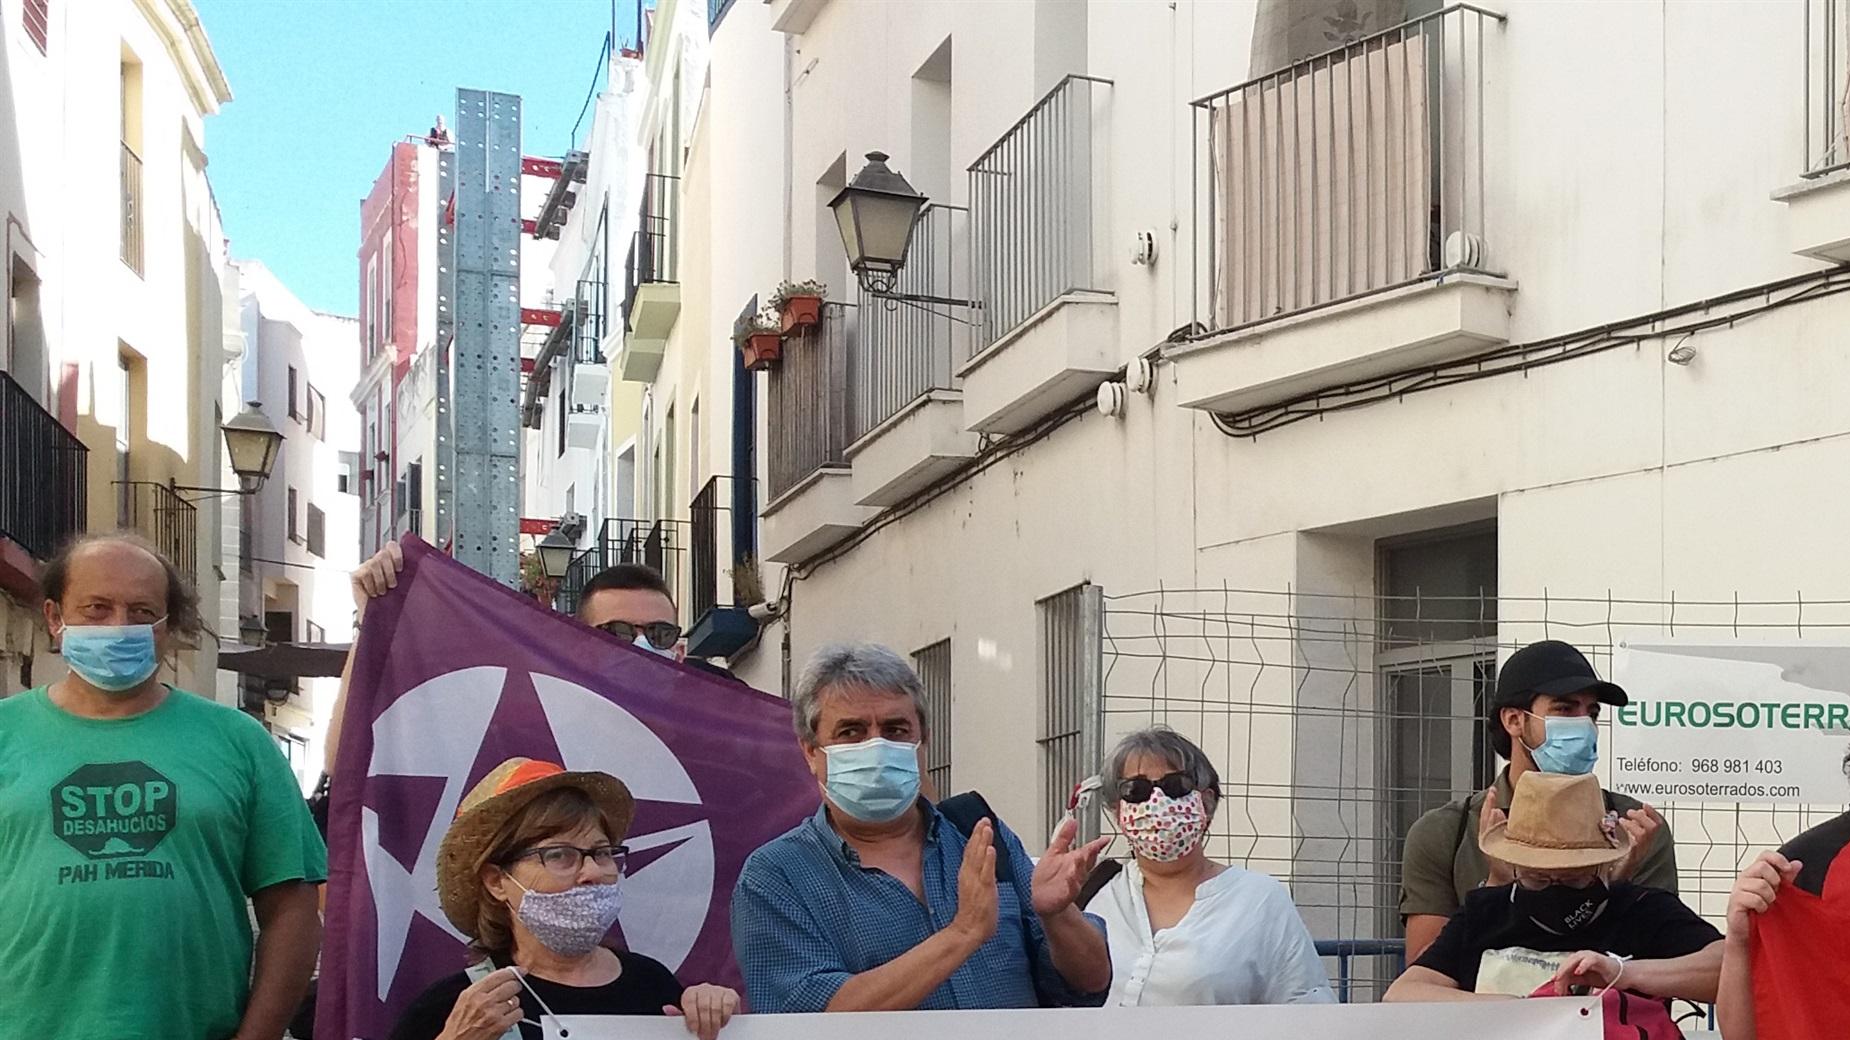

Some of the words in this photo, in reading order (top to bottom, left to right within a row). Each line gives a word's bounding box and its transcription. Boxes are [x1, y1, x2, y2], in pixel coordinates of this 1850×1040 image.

[1616, 757, 1682, 773] Teléfono:
[1691, 758, 1719, 773] 968
[1723, 759, 1749, 774] 981
[1755, 760, 1783, 774] 403
[61, 781, 169, 818] STOP
[63, 814, 167, 836] DESAHUCIOS
[58, 864, 98, 885] PAH
[1564, 899, 1593, 924] BLACK
